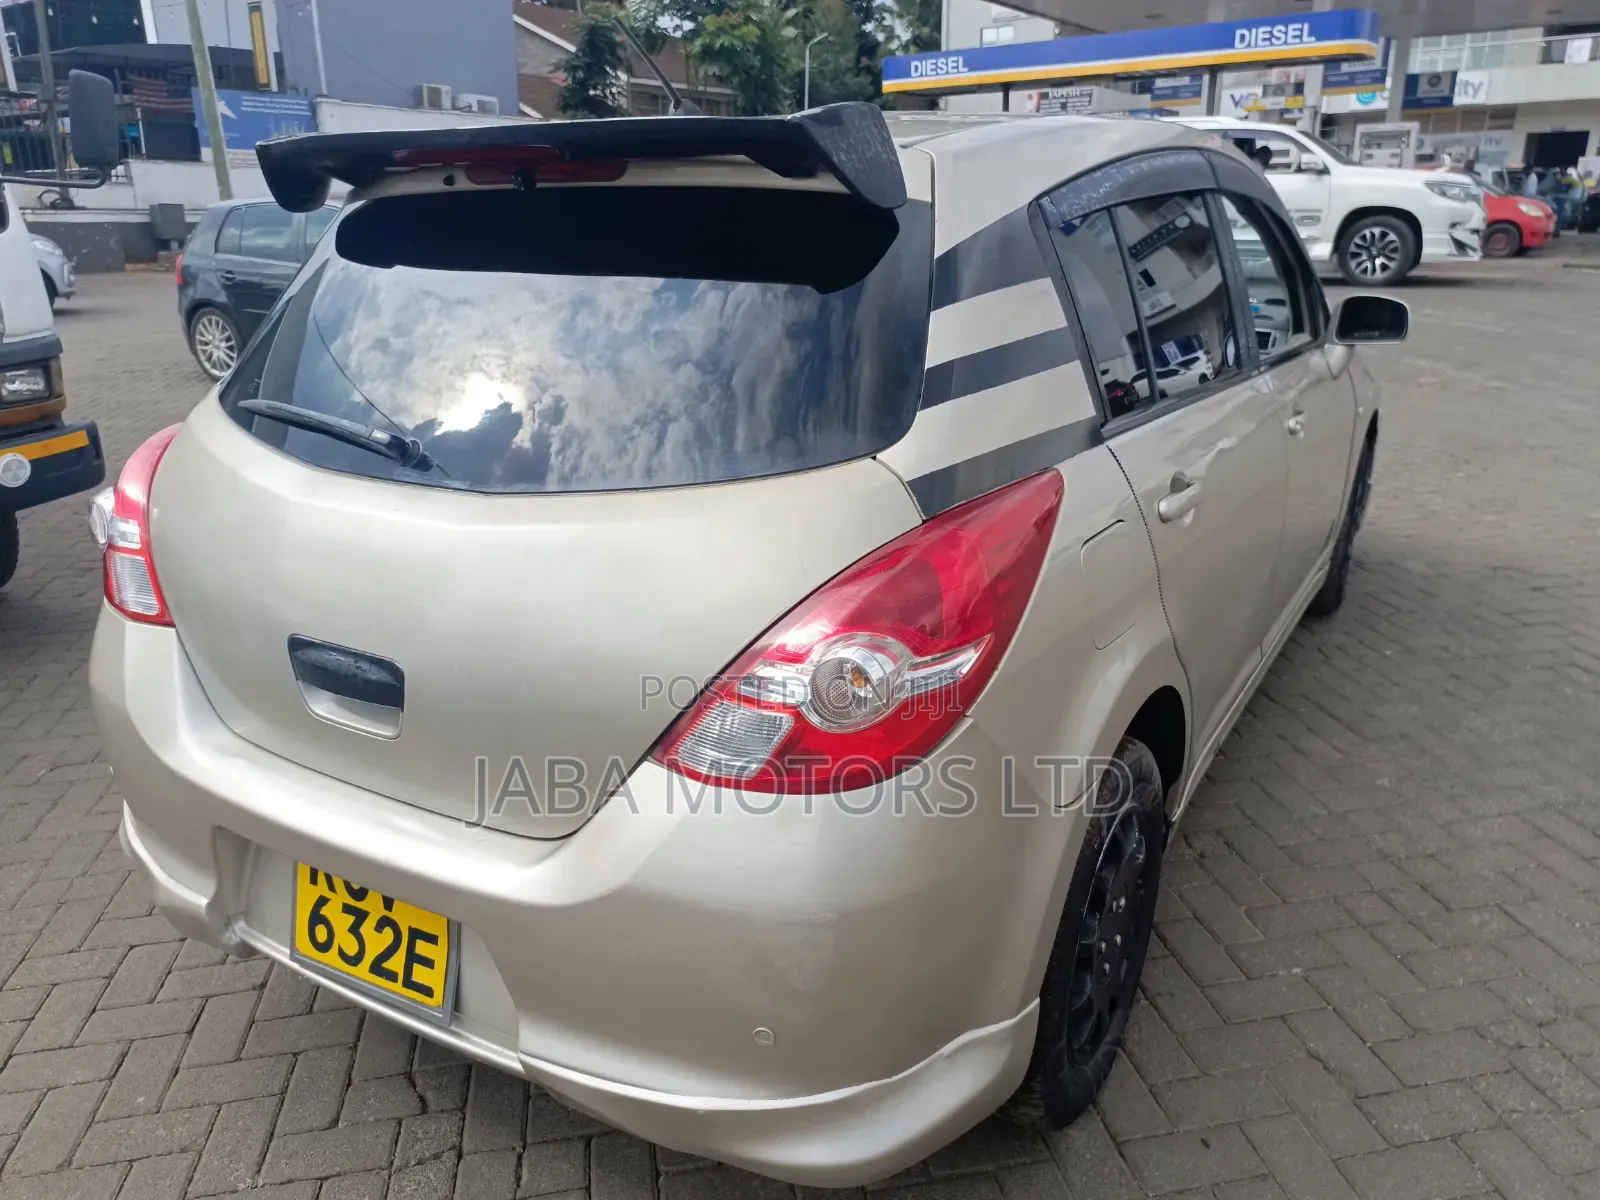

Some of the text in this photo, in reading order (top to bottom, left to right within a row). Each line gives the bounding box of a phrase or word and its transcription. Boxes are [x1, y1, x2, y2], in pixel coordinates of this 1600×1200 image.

[1234, 22, 1316, 49] DIESEL
[910, 56, 969, 78] DIESEL
[307, 894, 440, 999] 632E
